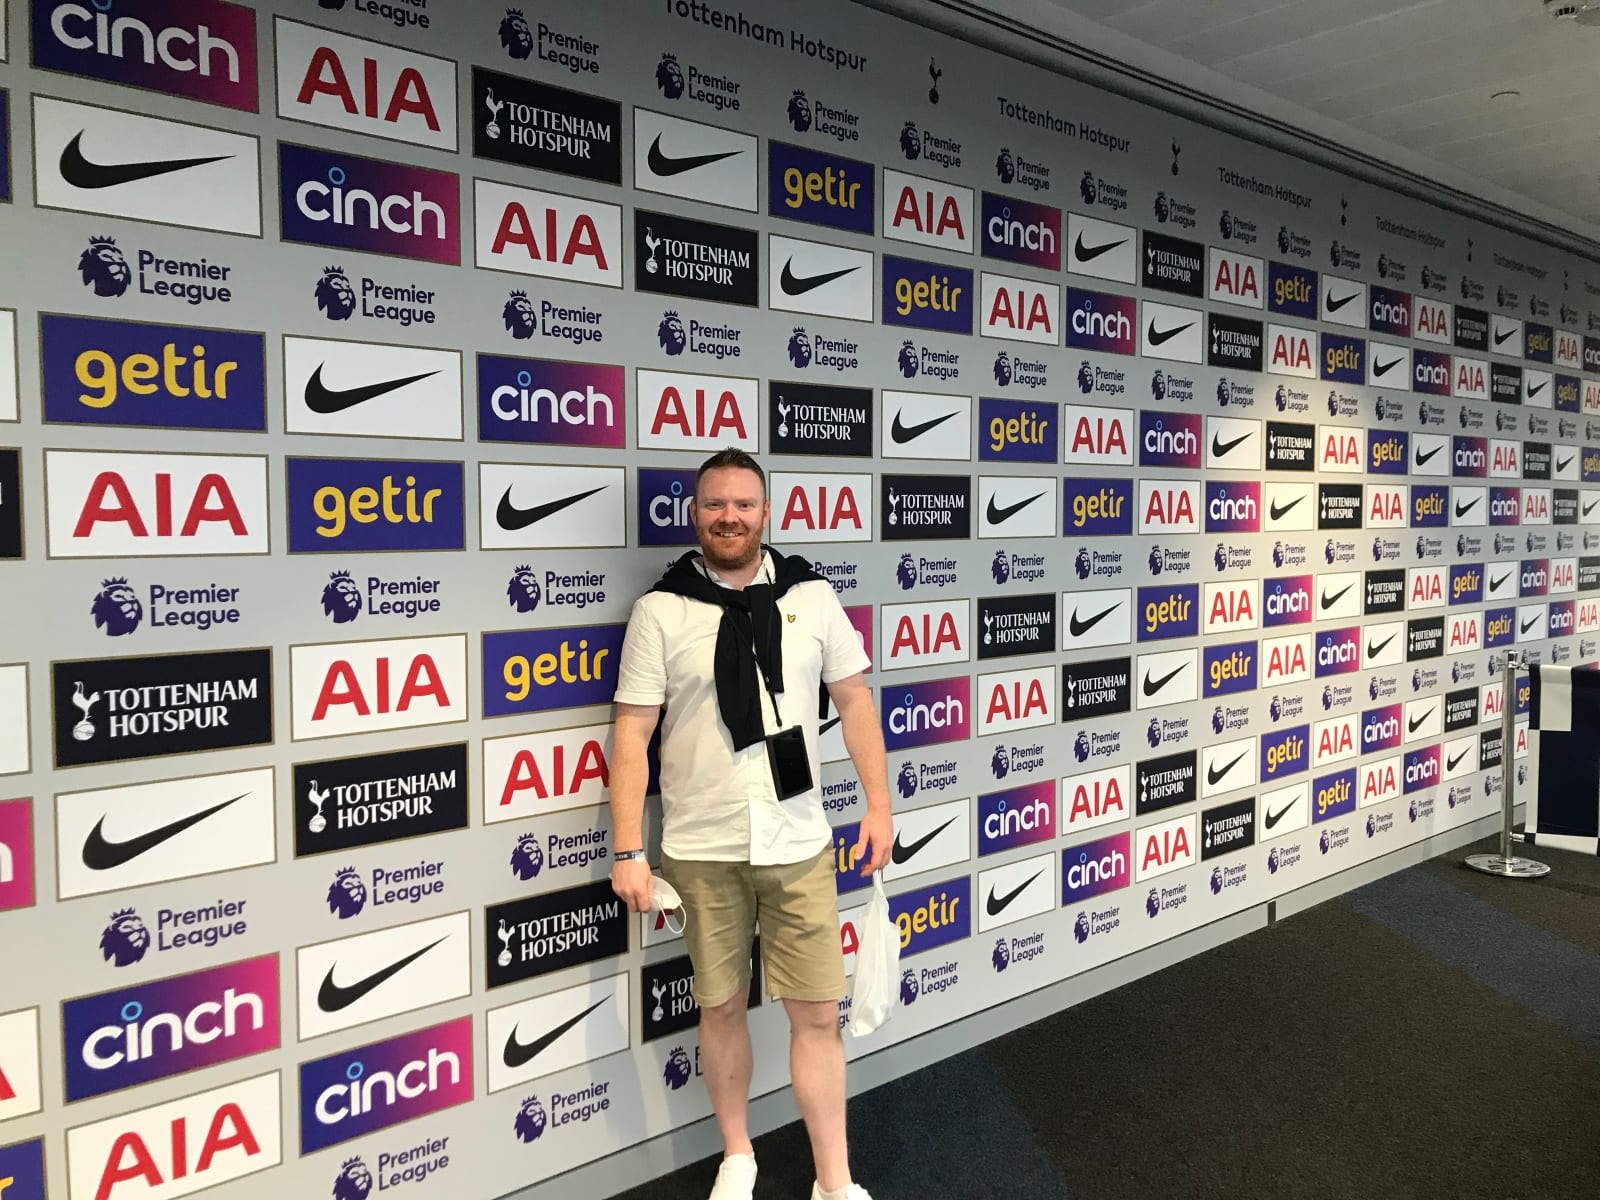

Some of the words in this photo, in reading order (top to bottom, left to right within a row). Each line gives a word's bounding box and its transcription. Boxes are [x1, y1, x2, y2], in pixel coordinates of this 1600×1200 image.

[355, 0, 430, 28] League
[51, 0, 238, 82] cinch
[538, 23, 599, 56] Premier
[665, 0, 784, 48] Tottenham
[790, 30, 867, 72] Hotspur
[538, 41, 599, 74] League
[297, 47, 440, 132] AIA
[506, 101, 610, 143] TOTTENHAM
[997, 96, 1076, 136] Tottenham
[1080, 122, 1130, 152] Hotspur
[510, 124, 591, 159] HOTSPUR
[923, 130, 961, 153] Premier
[923, 144, 961, 168] League
[784, 167, 860, 209] getir
[1098, 178, 1127, 197] Premier
[1098, 190, 1127, 211] League
[1218, 167, 1274, 198] Tottenham
[1276, 184, 1312, 208] Hotspur
[296, 167, 445, 239] cinch
[893, 186, 964, 240] AIA
[491, 202, 607, 270] AIA
[988, 207, 1054, 253] cinch
[139, 250, 230, 280] Premier
[662, 238, 749, 269] TOTTENHAM
[1156, 250, 1199, 271] TOTTENHAM
[666, 259, 733, 285] HOTSPUR
[1156, 264, 1191, 283] HOTSPUR
[1214, 259, 1258, 299] AIA
[140, 272, 230, 305] League
[362, 278, 435, 304] Premier
[895, 275, 961, 315] getir
[362, 298, 436, 327] League
[989, 287, 1051, 333] AIA
[1072, 299, 1130, 340] cinch
[690, 320, 740, 340] Premier
[815, 335, 858, 354] Premier
[1220, 330, 1259, 347] TOTTENHAM
[690, 336, 740, 360] League
[815, 350, 858, 371] League
[1220, 343, 1251, 358] HOTSPUR
[1272, 334, 1311, 369] AIA
[1326, 344, 1360, 374] getir
[75, 343, 236, 408] getir
[1014, 357, 1047, 373] Premier
[1014, 370, 1046, 389] League
[1167, 374, 1193, 388] Premier
[1167, 386, 1193, 402] League
[492, 371, 612, 426] cinch
[650, 386, 746, 438] AIA
[792, 404, 865, 424] TOTTENHAM
[794, 422, 851, 440] HOTSPUR
[990, 412, 1047, 451] getir
[1072, 416, 1126, 455] AIA
[1145, 420, 1196, 454] cinch
[1323, 434, 1359, 464] AIA
[1373, 438, 1403, 467] getir
[73, 472, 247, 537] AIA
[312, 476, 441, 537] getir
[780, 485, 862, 530] AIA
[901, 494, 964, 508] TOTTENHAM
[1073, 488, 1123, 527] getir
[1145, 490, 1193, 524] AIA
[1210, 489, 1256, 520] cinch
[1370, 492, 1402, 520] AIA
[903, 510, 952, 525] HOTSPUR
[919, 557, 956, 571] Premier
[1093, 551, 1122, 563] Premier
[1228, 546, 1251, 557] Premier
[1228, 557, 1251, 570] League
[545, 570, 605, 587] Premier
[814, 561, 858, 576] Premier
[919, 571, 956, 587] League
[1093, 563, 1121, 578] League
[150, 583, 239, 605] Premier
[546, 588, 605, 608] League
[829, 578, 858, 594] ague
[1267, 584, 1308, 614] cinch
[1412, 573, 1442, 602] AIA
[150, 606, 240, 630] League
[994, 611, 1049, 628] TOTTENHAM
[1146, 594, 1190, 632] getir
[1209, 589, 1253, 624] AIA
[890, 612, 960, 657] AIA
[996, 626, 1039, 644] HOTSPUR
[1450, 619, 1477, 647] AIA
[1266, 643, 1306, 678] AIA
[1319, 637, 1356, 665] cinch
[503, 640, 608, 701] getir
[1077, 673, 1125, 692] TOTTENHAM
[1210, 651, 1250, 688] getir
[103, 678, 256, 711] TOTTENHAM
[311, 654, 449, 721] AIA
[986, 678, 1047, 723] AIA
[1078, 689, 1116, 706] HOTSPUR
[110, 705, 229, 737] HOTSPUR
[889, 693, 962, 734] cinch
[1317, 723, 1353, 758] AIA
[1364, 715, 1398, 743] cinch
[1011, 743, 1043, 759] Premier
[1011, 758, 1043, 772] League
[1267, 735, 1303, 773] getir
[500, 740, 609, 805] AIA
[821, 779, 858, 796] remier
[1149, 765, 1192, 786] TOTTENHAM
[1363, 765, 1396, 800] AIA
[332, 770, 455, 806] TOTTENHAM
[1069, 777, 1123, 823] AIA
[1150, 781, 1184, 800] HOTSPUR
[1318, 778, 1351, 814] getir
[337, 796, 432, 829] HOTSPUR
[822, 795, 858, 812] eague
[985, 798, 1048, 839] cinch
[1213, 812, 1251, 833] TOTTENHAM
[1214, 827, 1244, 846] HOTSPUR
[548, 828, 607, 852] Premier
[1142, 826, 1190, 871] AIA
[548, 847, 607, 869] League
[1068, 849, 1124, 889] cinch
[1161, 883, 1187, 899] Premier
[1161, 895, 1187, 910] League
[157, 899, 245, 930] Premier
[517, 900, 617, 940] TOTTENHAM
[896, 892, 959, 948] getir
[158, 921, 246, 951] League
[521, 925, 599, 961] HOTSPUR
[921, 961, 958, 982] Premier
[921, 974, 958, 995] League
[84, 988, 261, 1069] cinch
[316, 1048, 459, 1123] cinch
[92, 1102, 260, 1200] AIA
[378, 1136, 448, 1172] Premier
[378, 1155, 449, 1191] League
